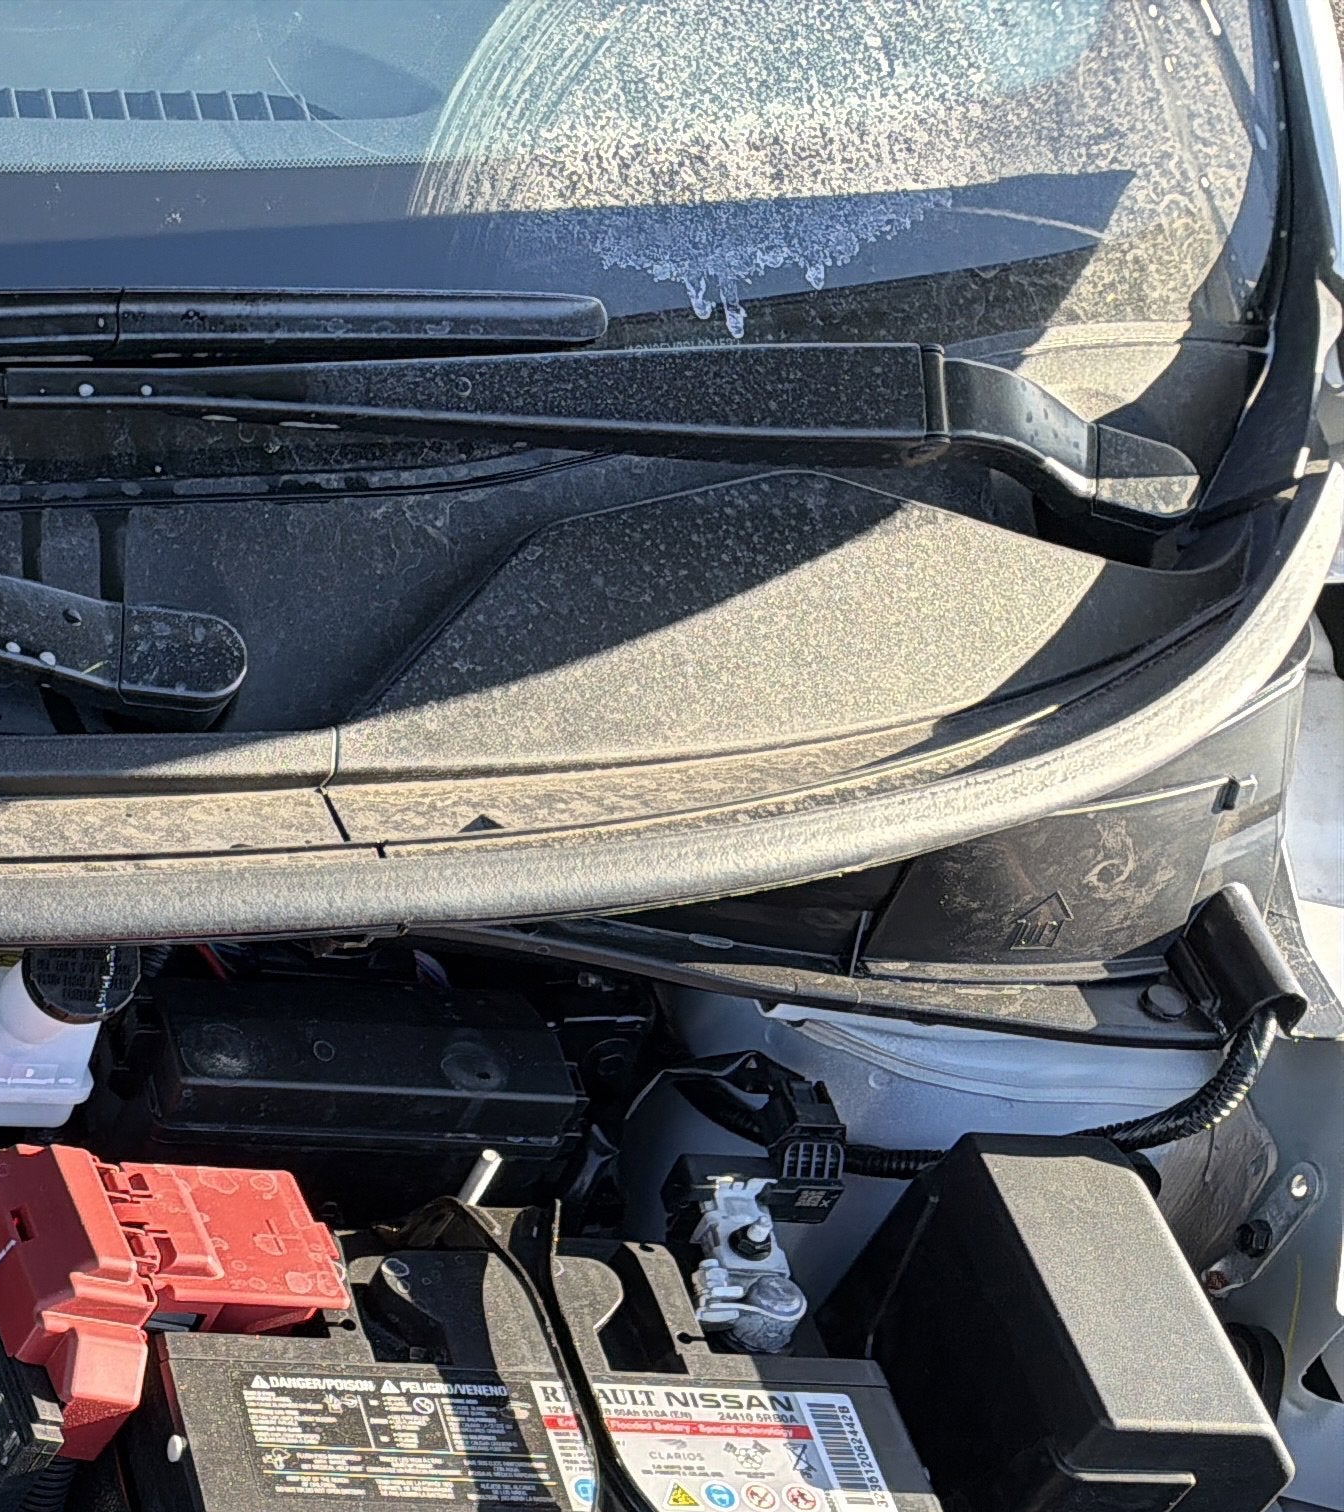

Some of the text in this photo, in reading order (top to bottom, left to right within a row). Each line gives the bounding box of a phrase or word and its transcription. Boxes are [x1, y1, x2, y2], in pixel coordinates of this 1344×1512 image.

[269, 1376, 376, 1393] DANGER/POISON
[400, 1381, 509, 1397] PELIGRO/VENENO
[539, 1386, 655, 1406] RAULT
[664, 1391, 795, 1412] NISSAN
[717, 1412, 753, 1422] 24410
[612, 1420, 651, 1431] Flooded
[653, 1421, 690, 1433] Battery
[698, 1423, 736, 1435] Special
[648, 1451, 705, 1461] CLARIOS
